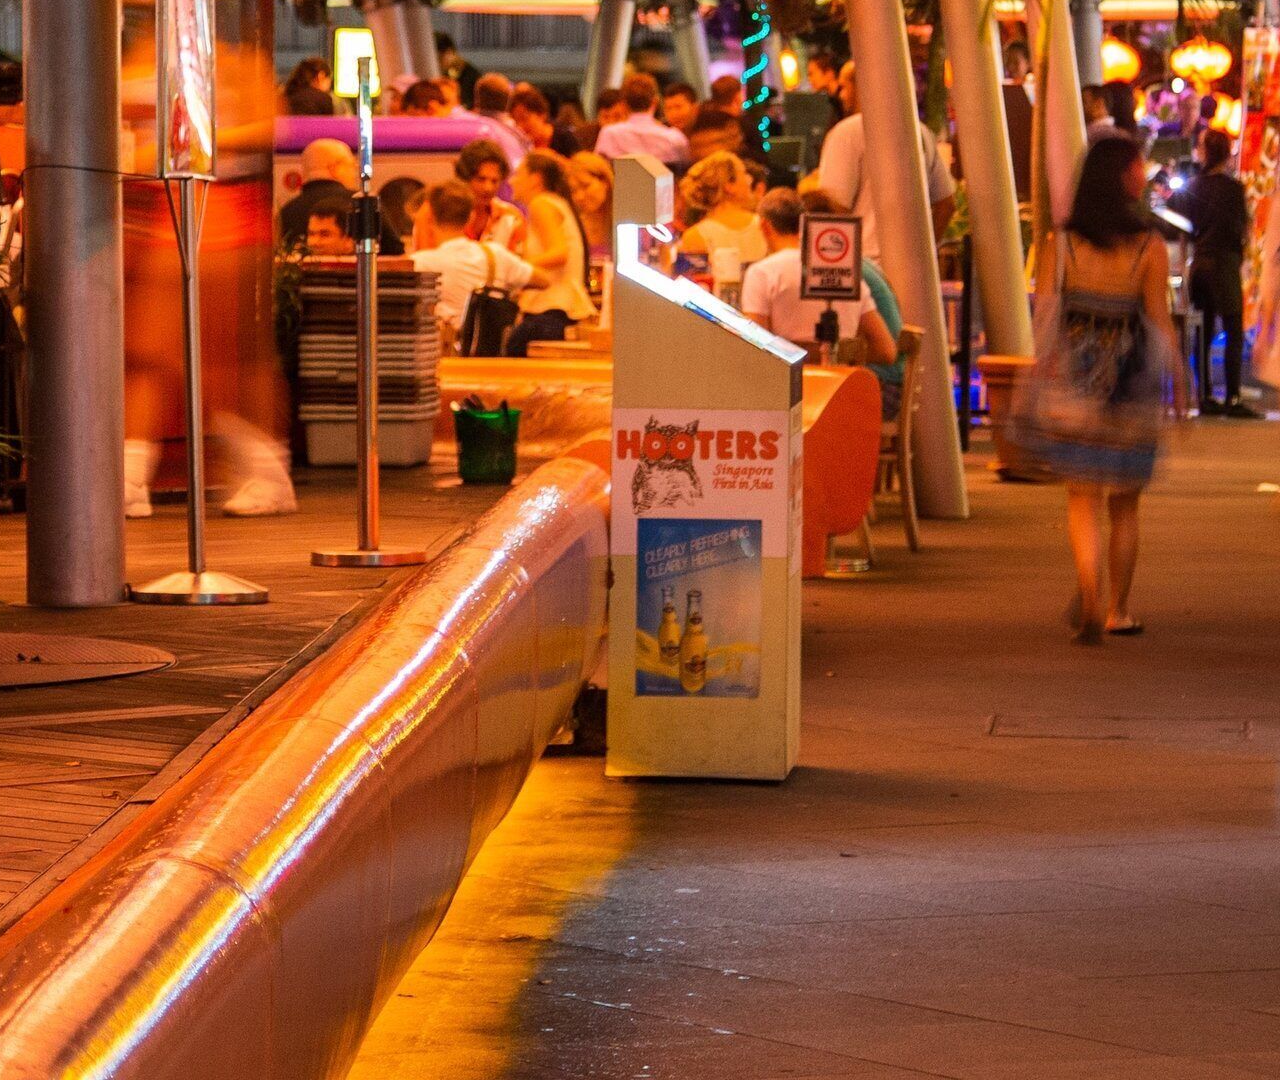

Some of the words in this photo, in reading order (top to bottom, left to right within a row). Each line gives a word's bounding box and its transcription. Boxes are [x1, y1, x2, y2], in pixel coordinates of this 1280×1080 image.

[616, 429, 780, 461] HOOTERS
[712, 463, 774, 478] Singapore
[712, 477, 736, 490] First
[738, 480, 749, 490] in
[749, 478, 774, 491] Asia
[644, 542, 688, 566] CLEARLY
[690, 525, 751, 552] REFRESHING
